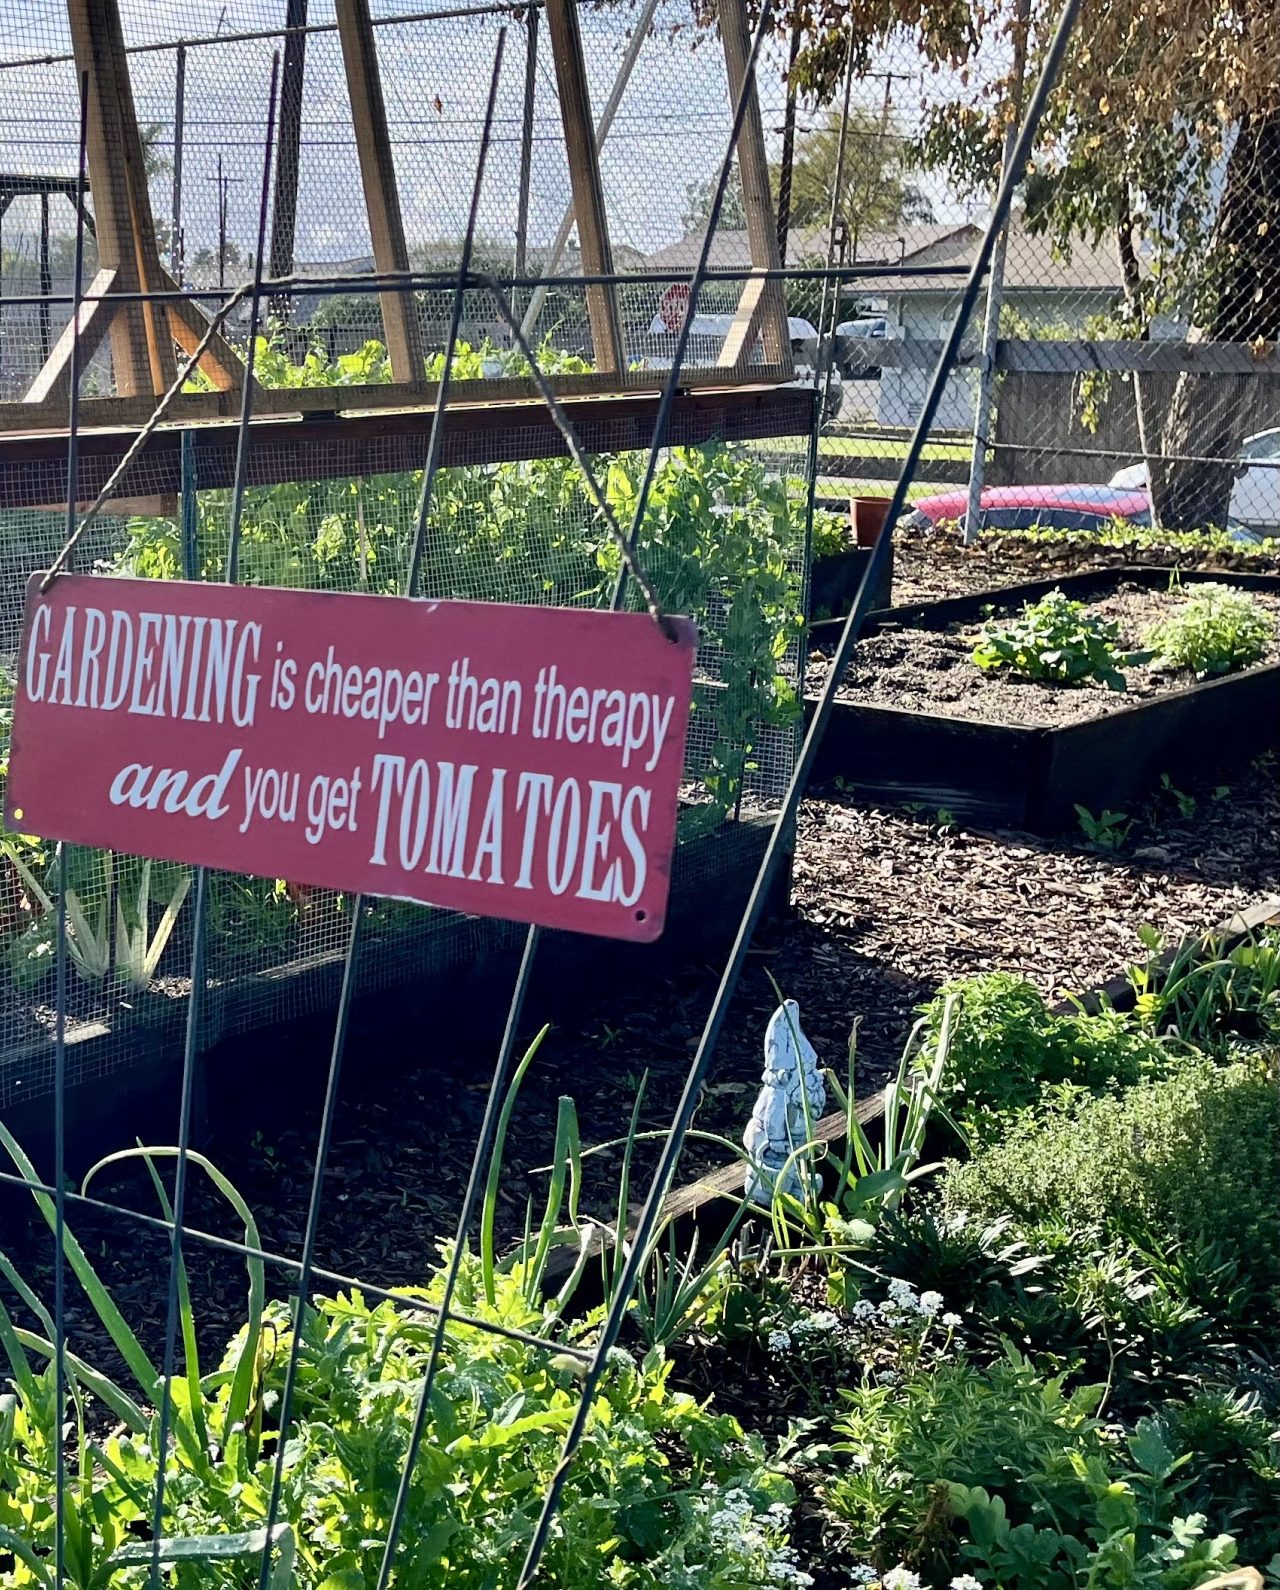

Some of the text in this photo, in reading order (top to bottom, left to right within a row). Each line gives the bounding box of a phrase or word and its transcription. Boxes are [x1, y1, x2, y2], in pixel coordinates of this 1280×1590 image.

[27, 604, 676, 772] GARDENING is cheaper than therapy
[110, 749, 652, 907] and you get TOMATOES
